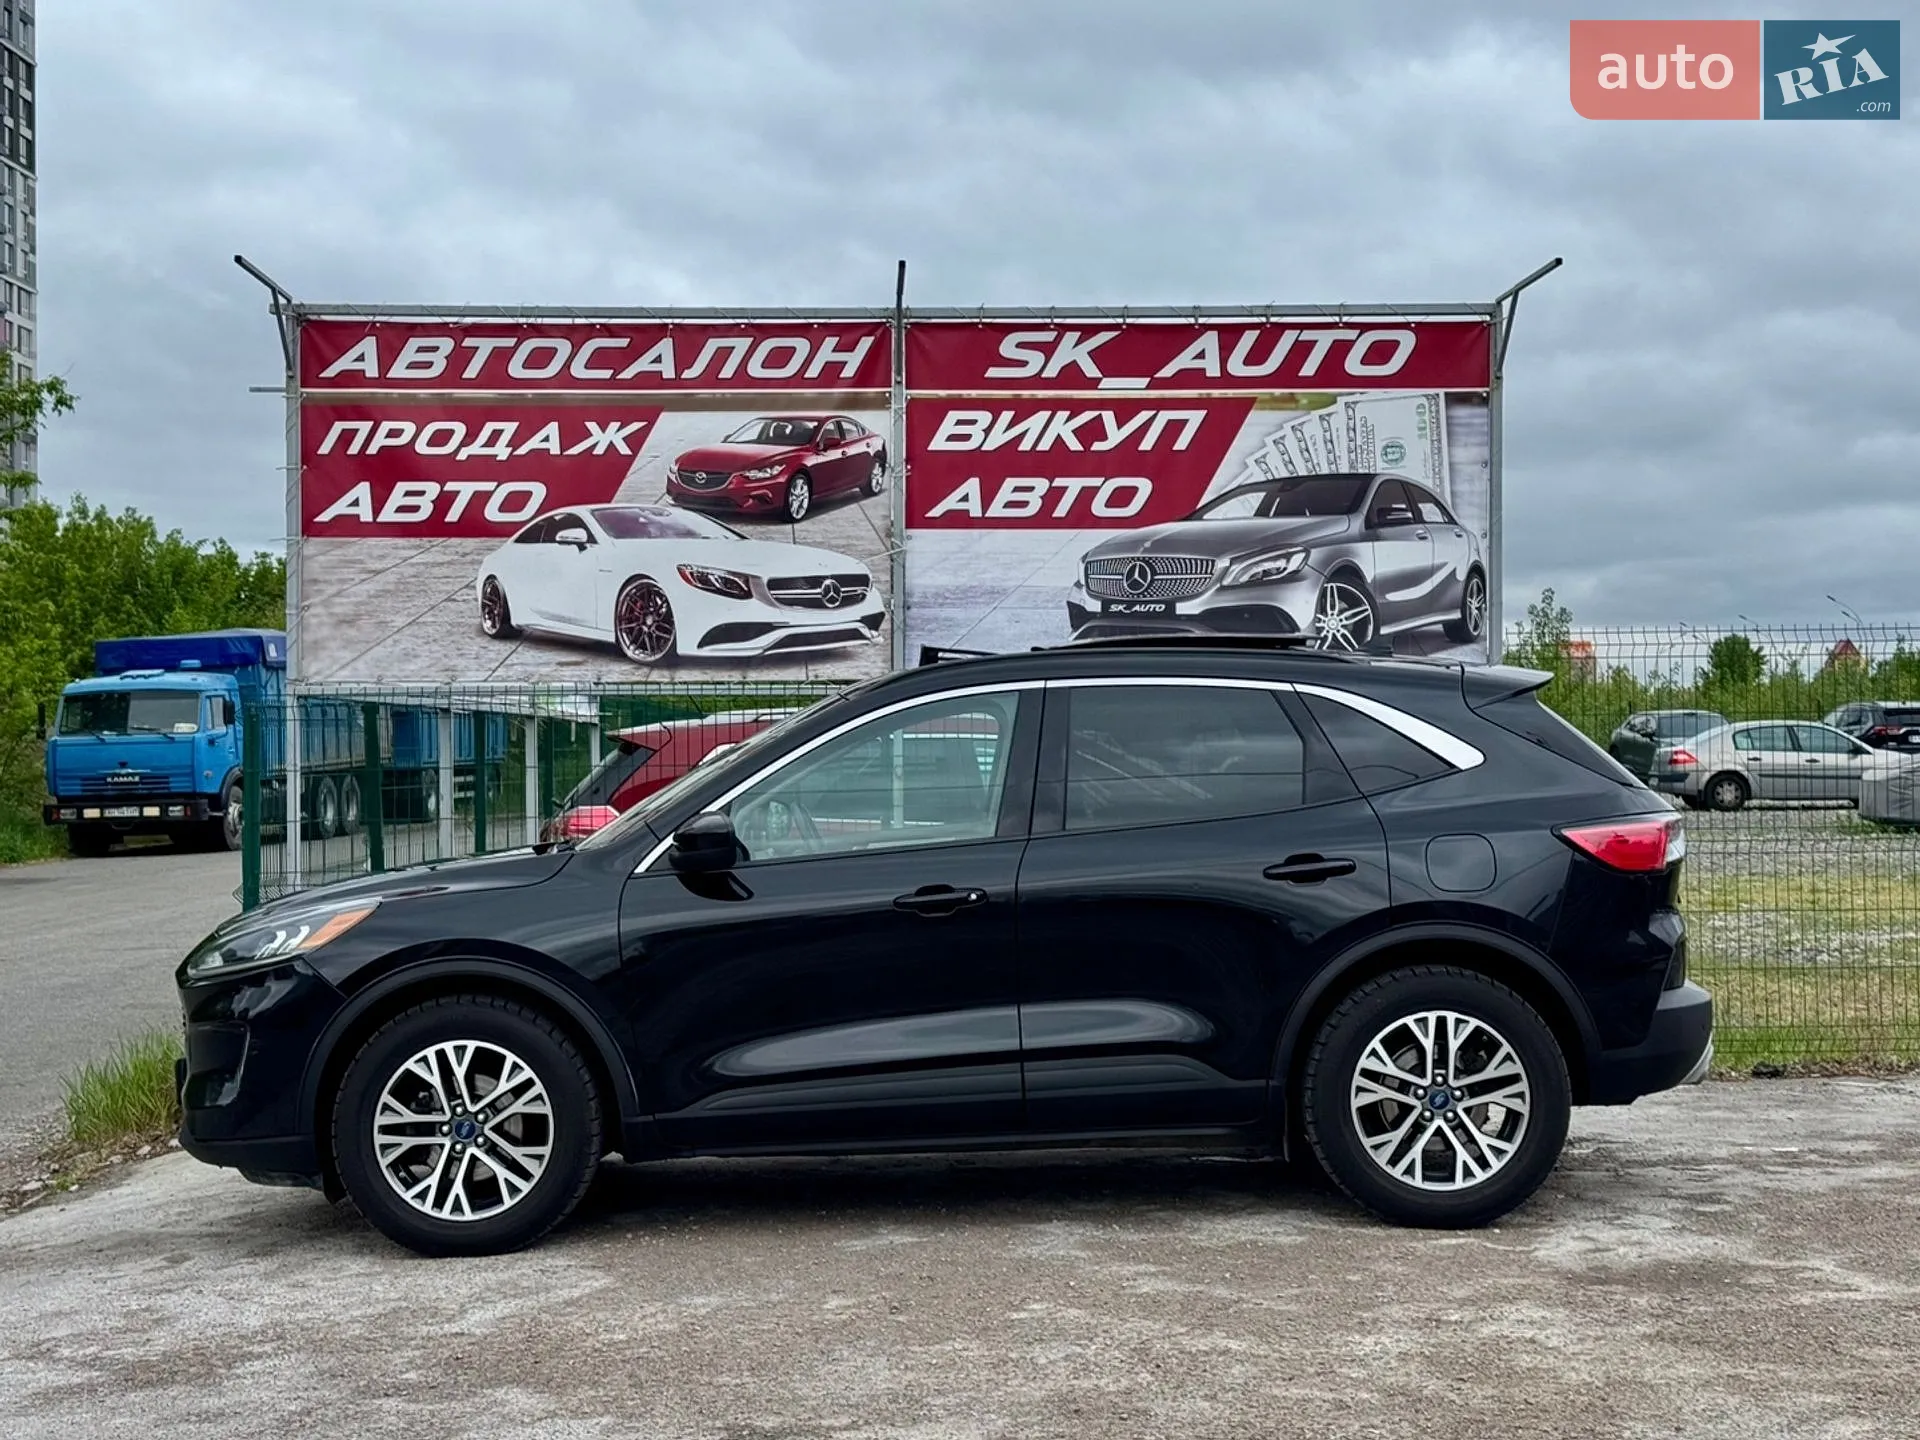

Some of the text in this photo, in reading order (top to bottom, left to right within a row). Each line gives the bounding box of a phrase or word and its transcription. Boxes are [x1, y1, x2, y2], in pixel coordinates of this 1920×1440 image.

[318, 335, 876, 380] АВТОСАЛОН
[984, 329, 1417, 389] SK_AUTO
[316, 420, 648, 461] ПРОДАЖ
[927, 409, 1208, 453] ВИКУП
[313, 480, 548, 524] АВТО
[924, 476, 1154, 518] АВТО
[1108, 603, 1166, 613] SK_AUTO
